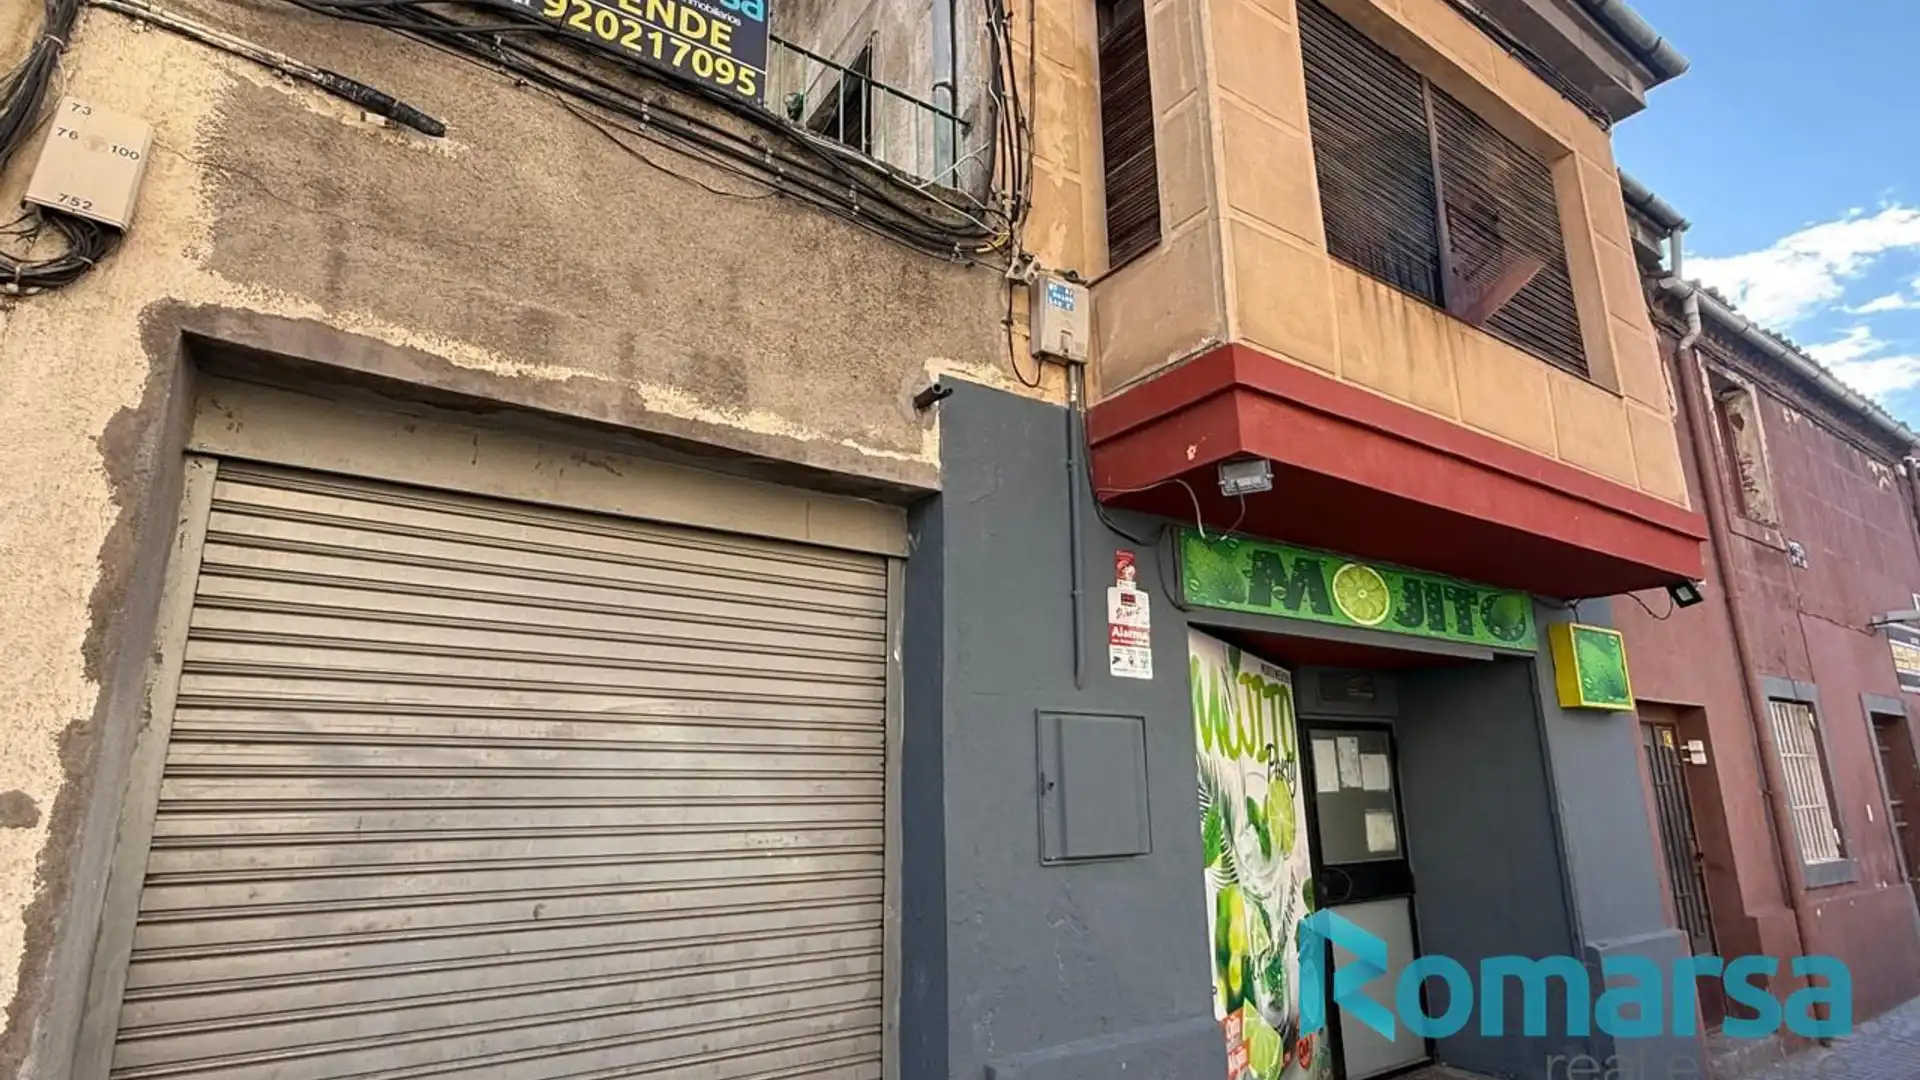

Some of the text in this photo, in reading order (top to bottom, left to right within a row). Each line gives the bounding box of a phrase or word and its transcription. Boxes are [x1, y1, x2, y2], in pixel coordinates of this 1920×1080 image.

[543, 0, 756, 97] 920217095
[71, 102, 92, 116] 73
[56, 127, 79, 141] 76
[111, 145, 140, 161] 100
[58, 193, 93, 211] 752
